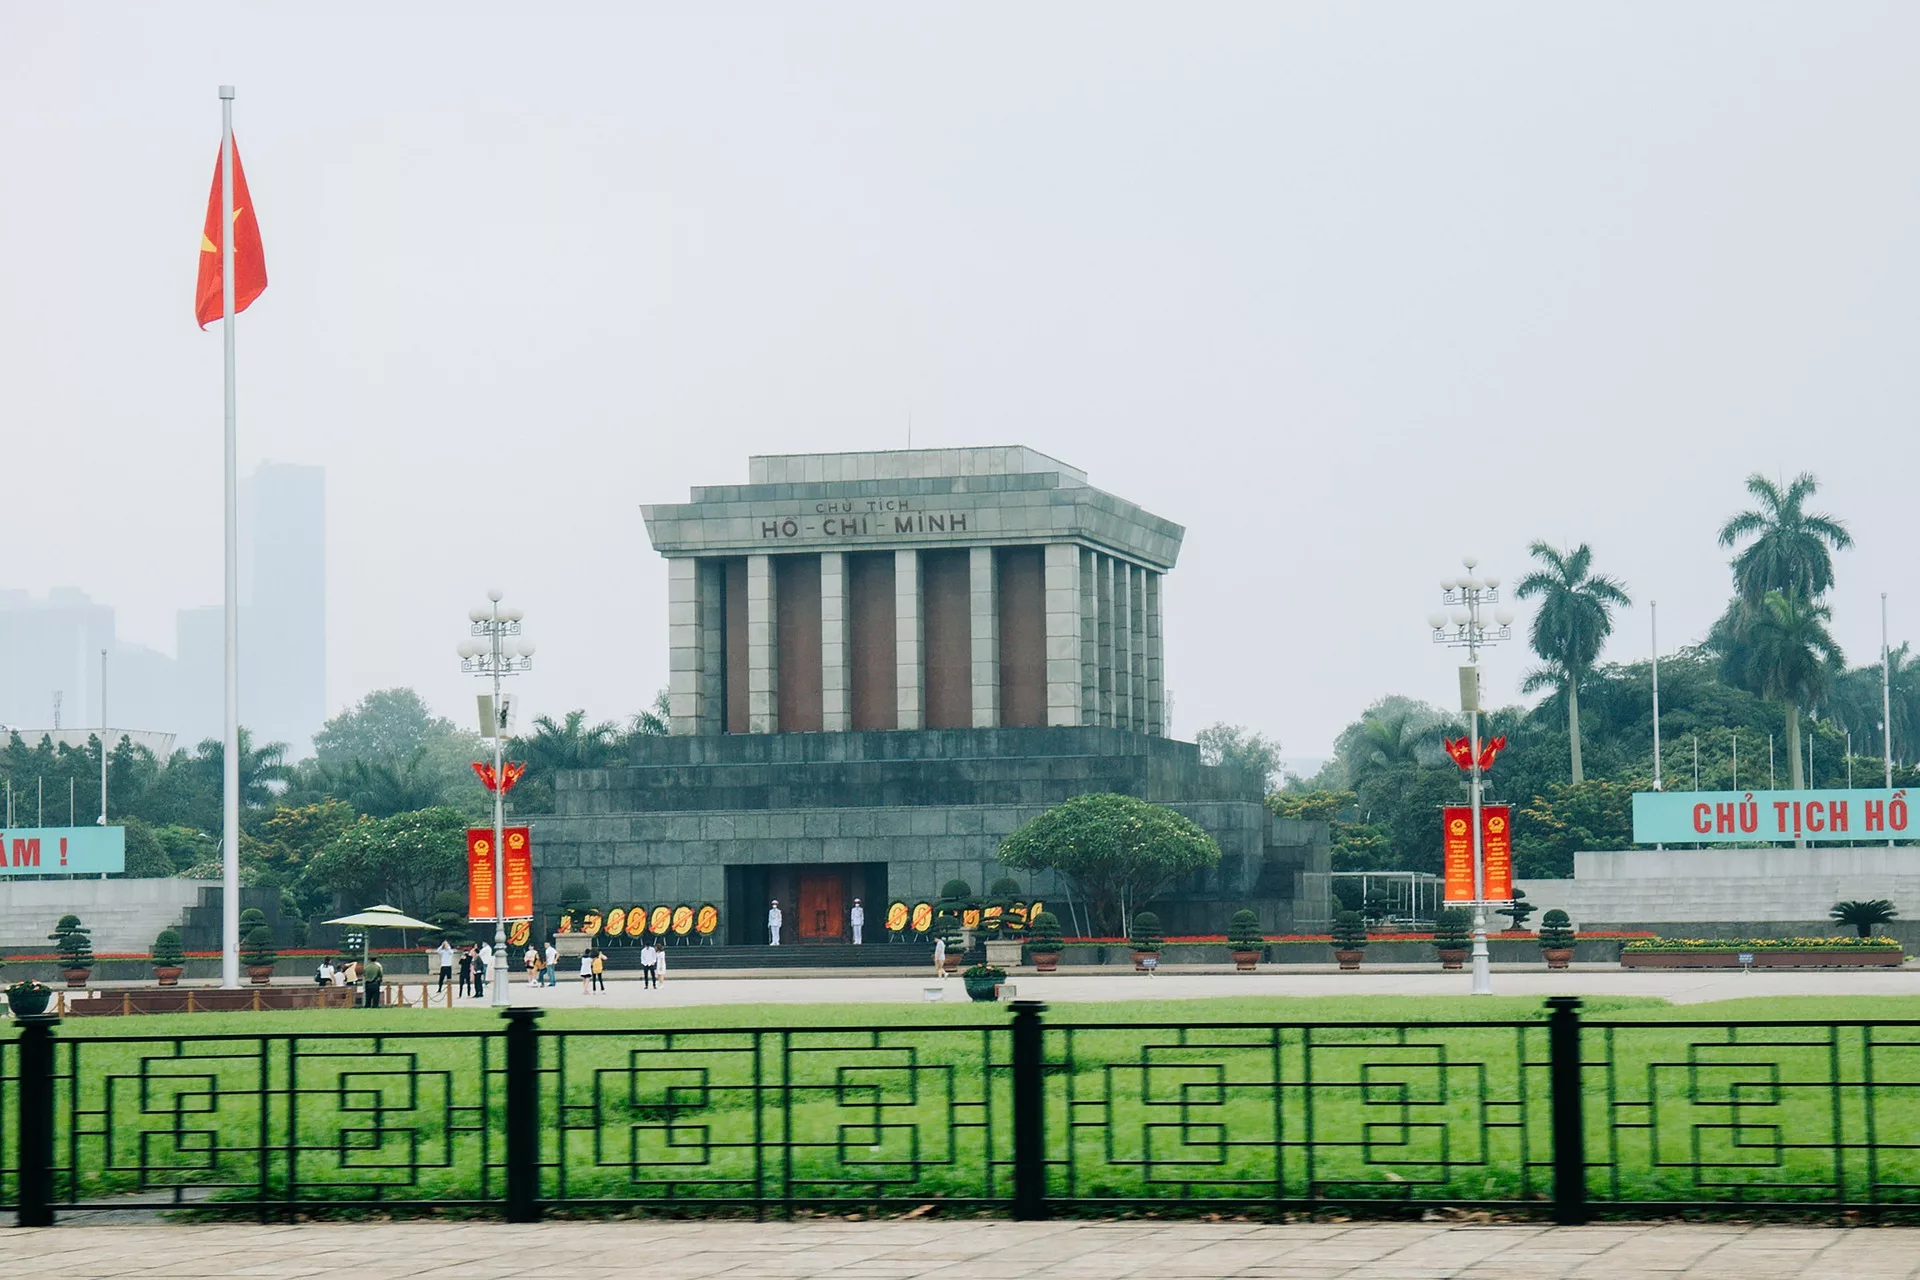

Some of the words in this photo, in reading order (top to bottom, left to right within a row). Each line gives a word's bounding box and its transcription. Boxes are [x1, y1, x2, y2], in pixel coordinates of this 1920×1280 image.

[1693, 793, 1758, 834] CHỦ
[1773, 801, 1848, 839] TỊCH
[1865, 790, 1908, 832] HỒ
